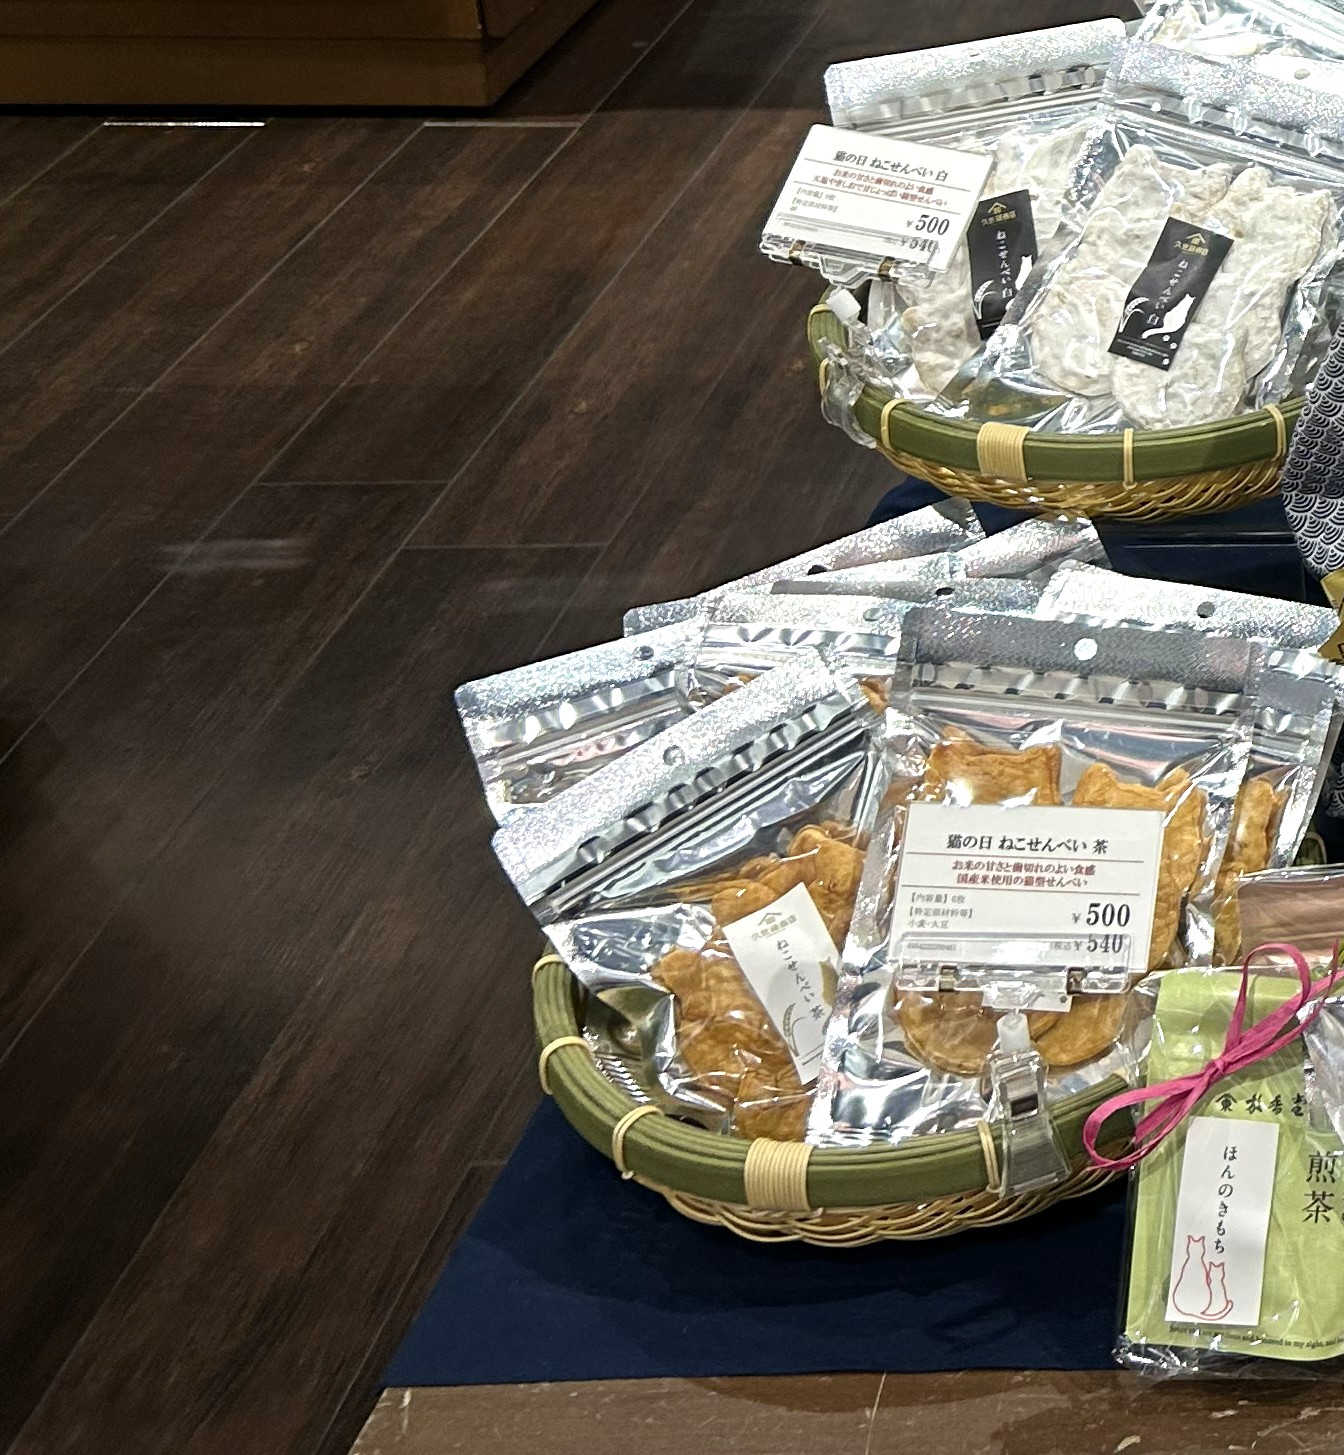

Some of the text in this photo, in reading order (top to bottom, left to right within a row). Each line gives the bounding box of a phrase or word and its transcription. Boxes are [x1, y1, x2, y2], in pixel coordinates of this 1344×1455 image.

[999, 836, 1087, 852] ねこせんべい
[1092, 840, 1108, 855] 茶
[1214, 1145, 1237, 1254] ほんのきもち
[1300, 1150, 1336, 1225] 煎茶
